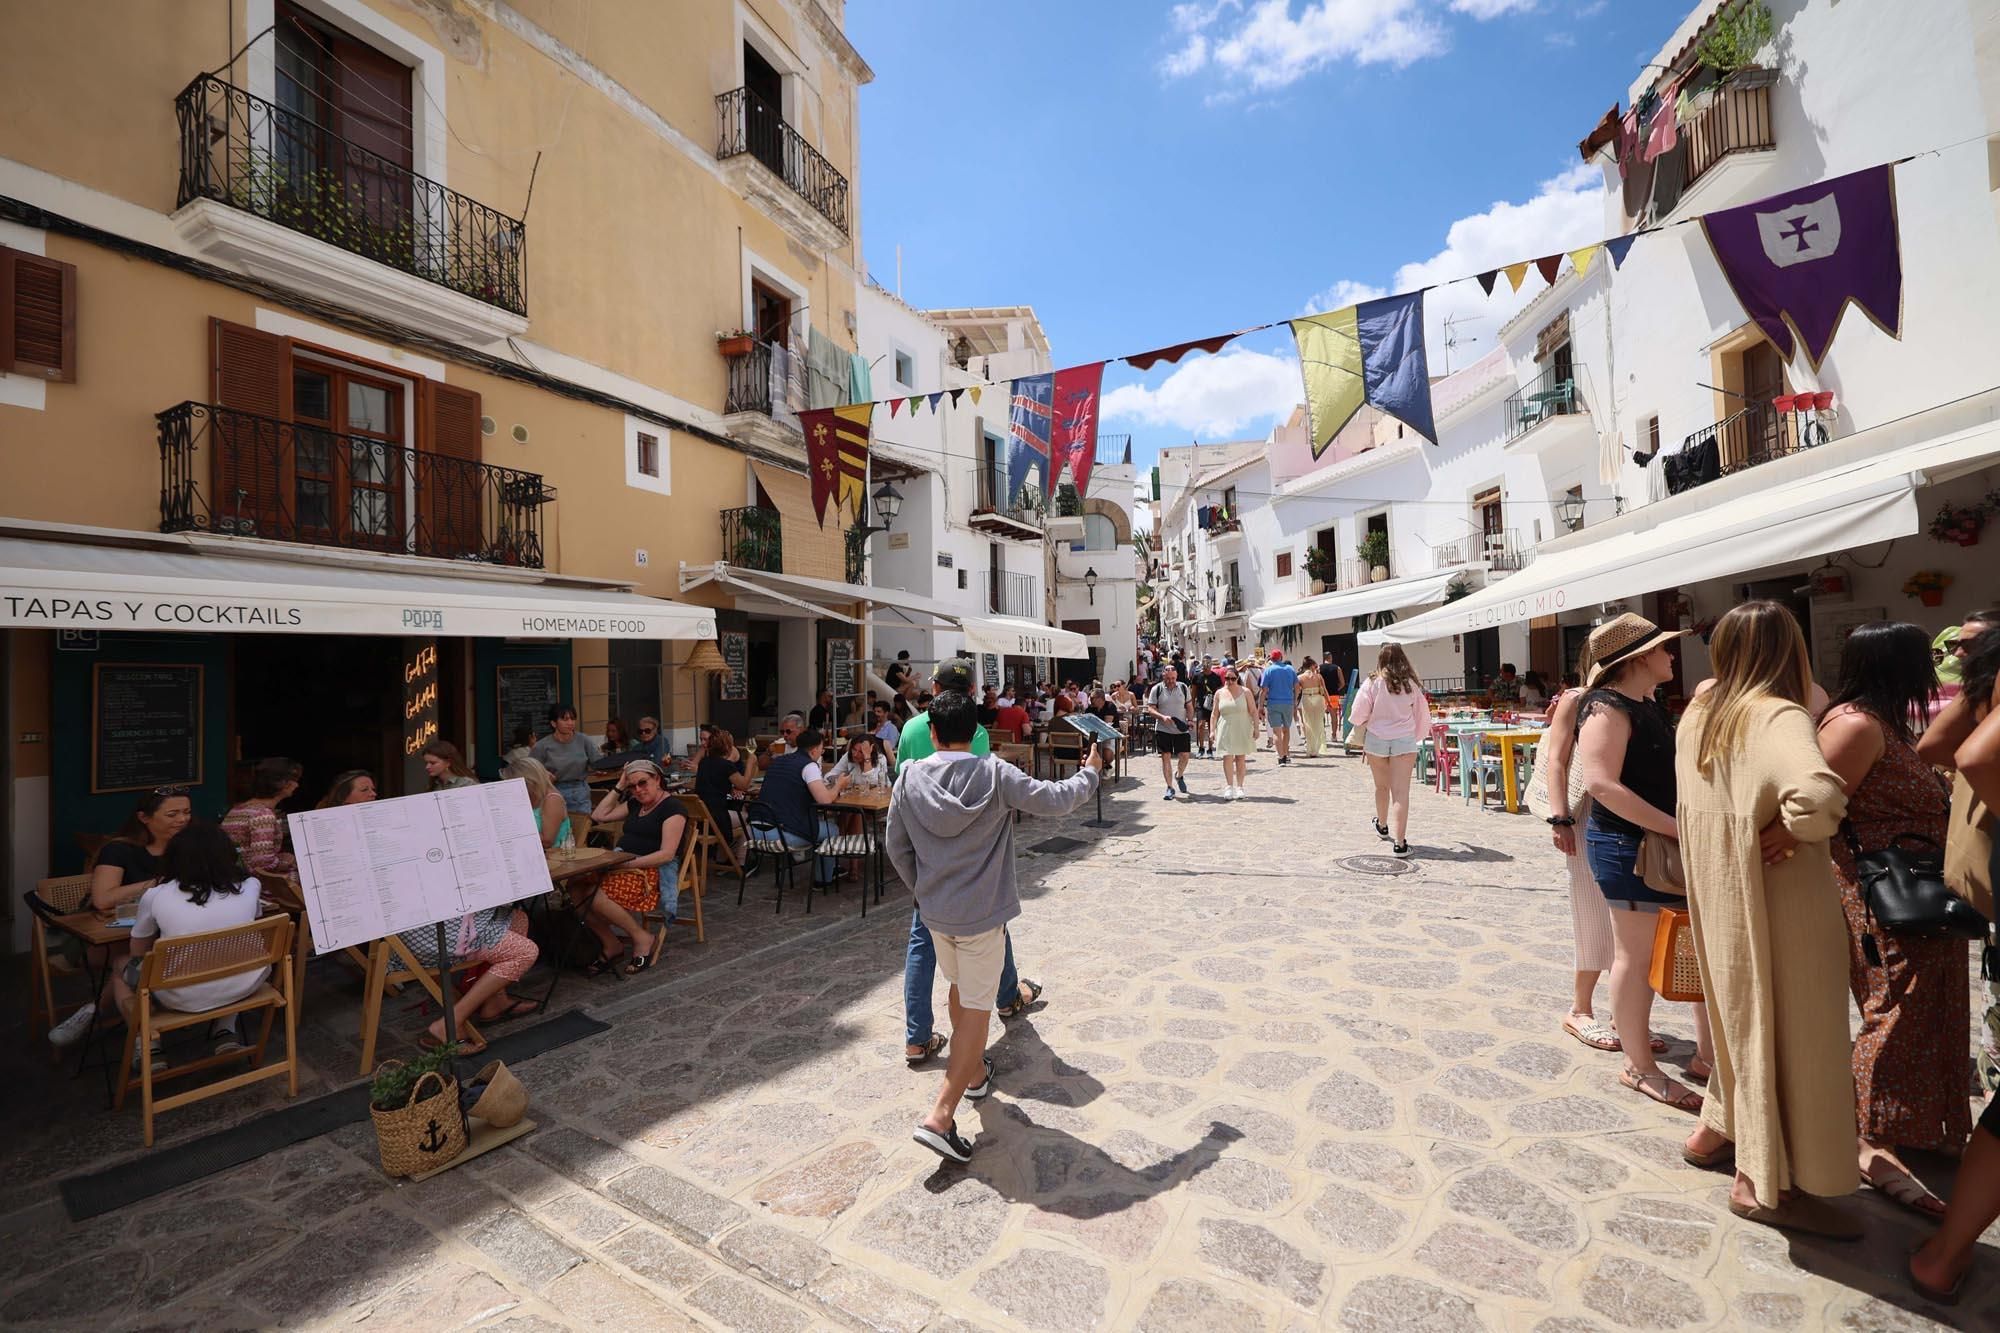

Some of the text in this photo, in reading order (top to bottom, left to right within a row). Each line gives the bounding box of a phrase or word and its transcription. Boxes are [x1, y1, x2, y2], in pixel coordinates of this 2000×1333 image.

[4, 597, 301, 625] TAPAS Y COCKTAILS
[1468, 590, 1566, 628] EL OLIVO MIO
[522, 617, 646, 633] HOMEMADE FOOD
[1018, 635, 1053, 654] BONITO
